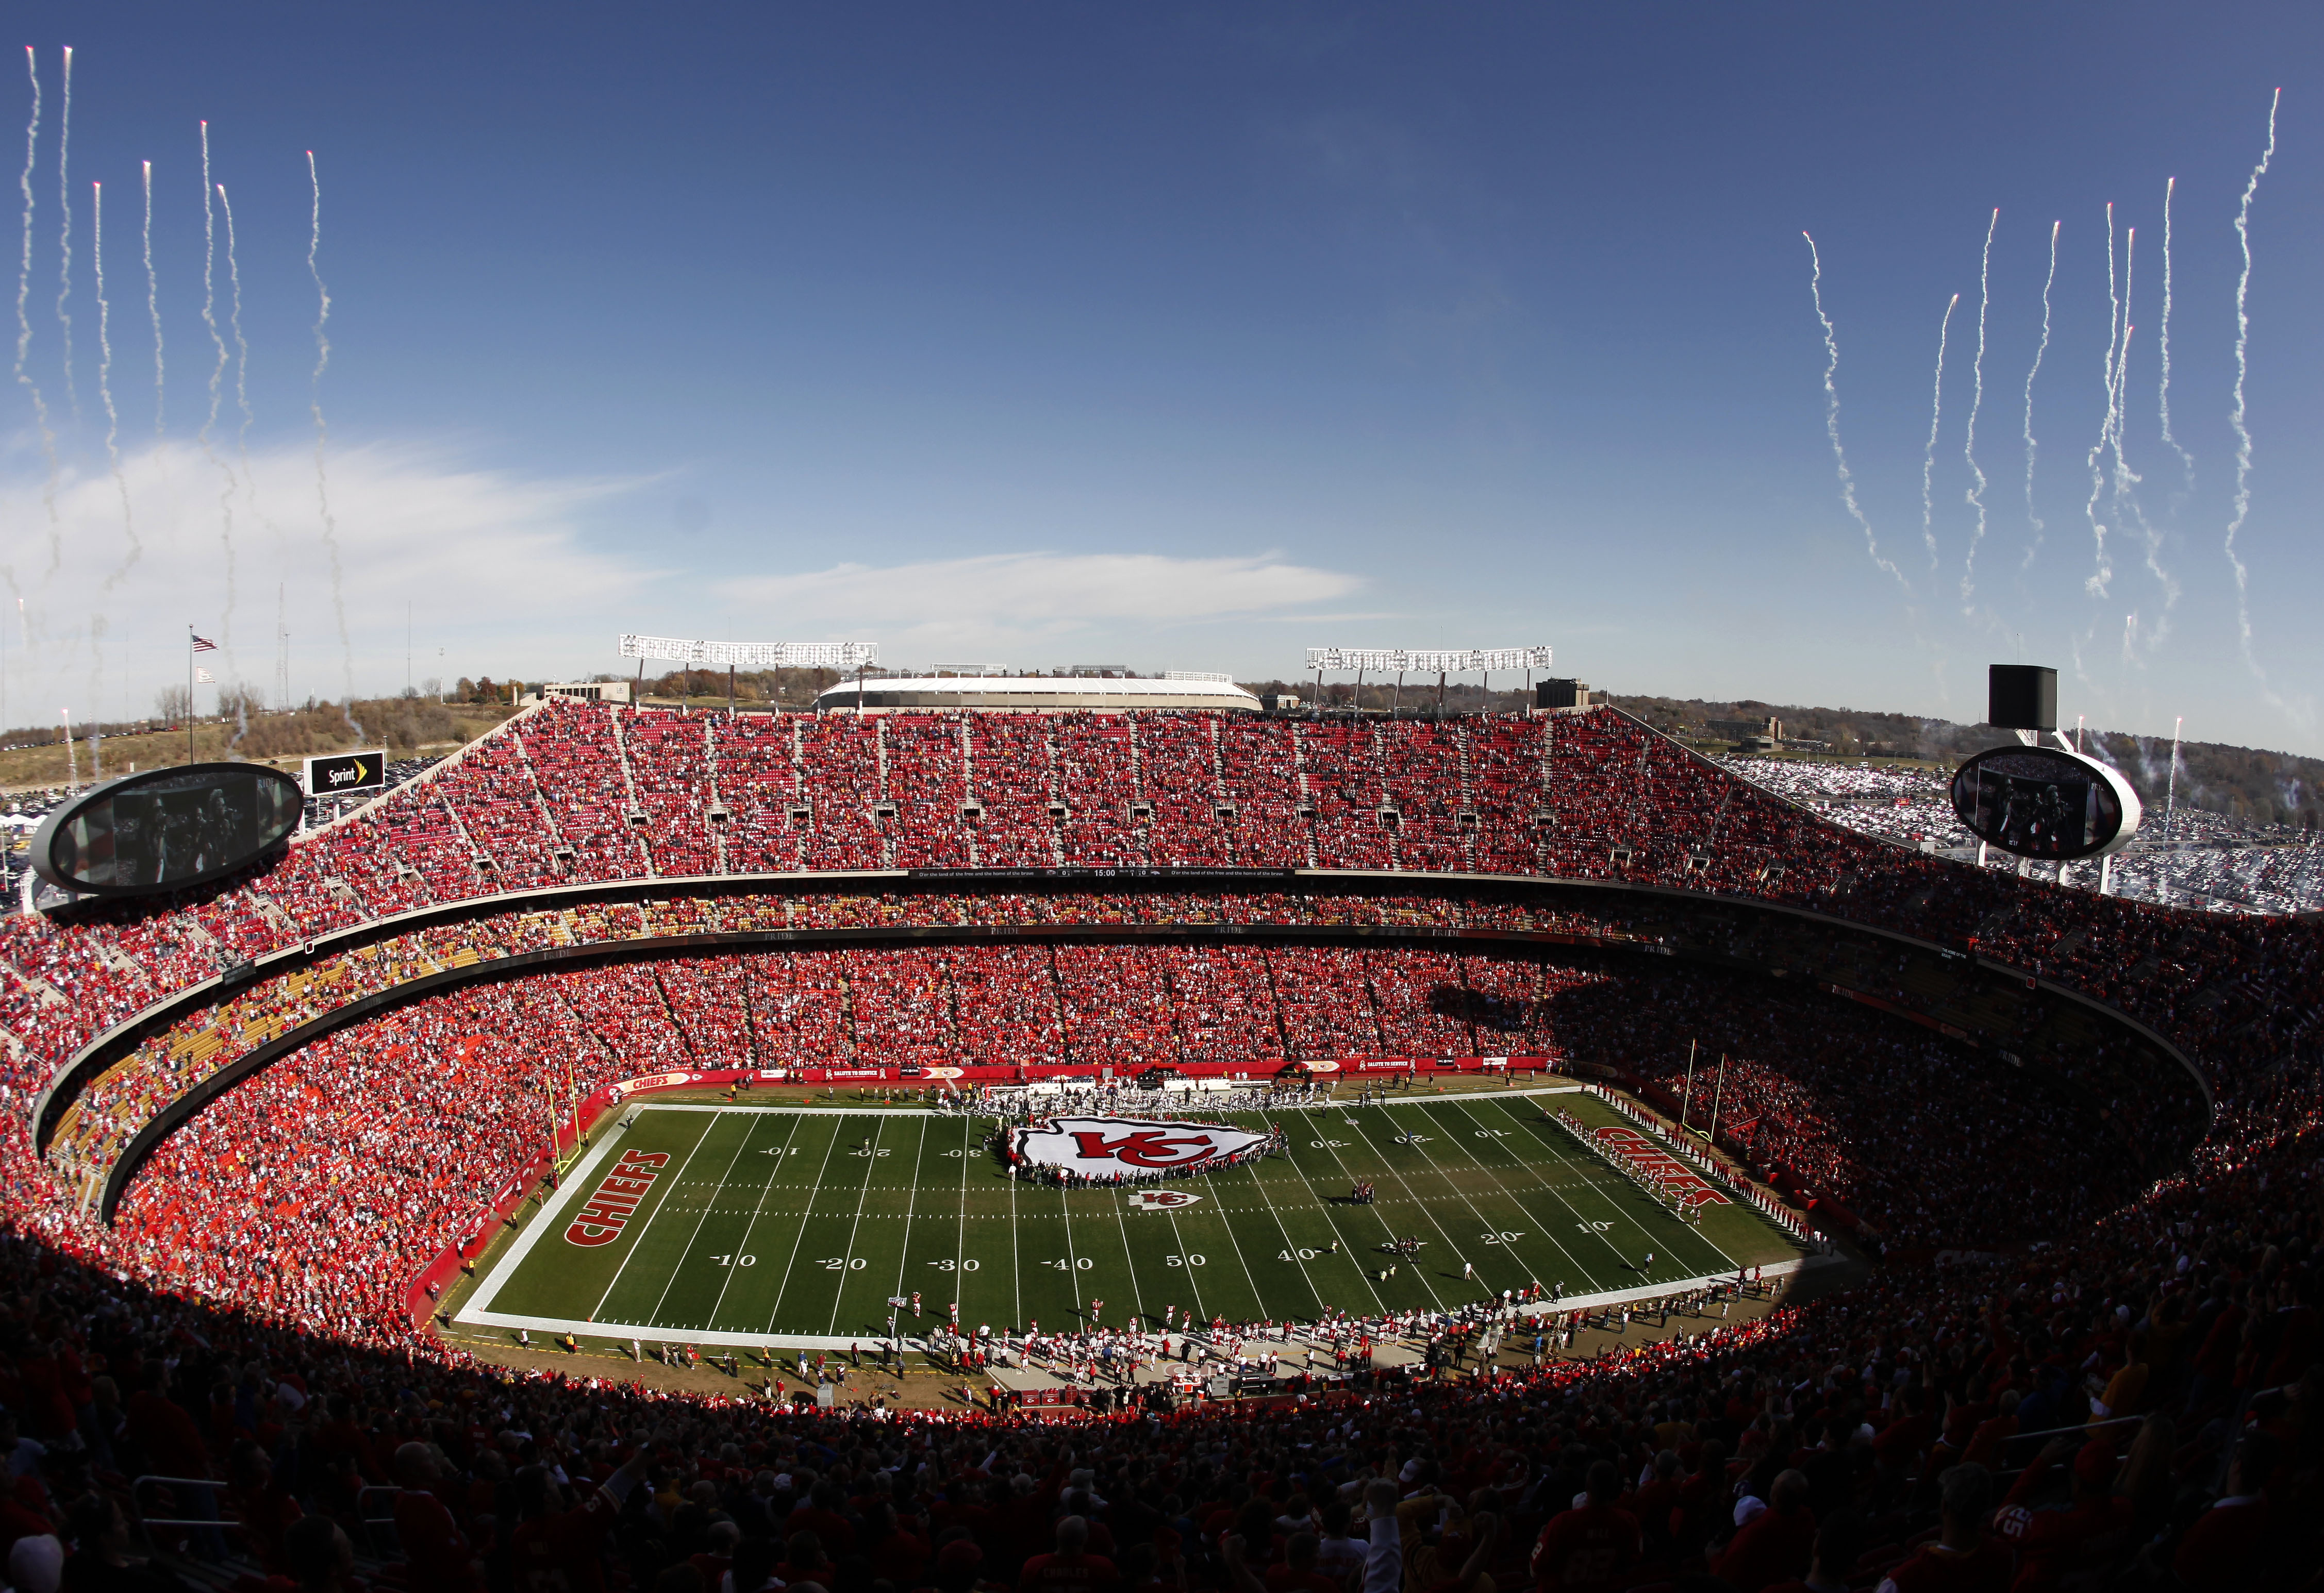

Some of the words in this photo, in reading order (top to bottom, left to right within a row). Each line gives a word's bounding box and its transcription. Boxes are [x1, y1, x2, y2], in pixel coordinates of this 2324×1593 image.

[329, 767, 355, 786] Sprint
[765, 932, 795, 941] PRIDE
[1432, 928, 1460, 937] PRIDE
[543, 949, 571, 961] PRIDE
[1645, 944, 1672, 956] PRIDE
[1832, 984, 1856, 999] PRIDE
[1998, 1048, 2022, 1067] PRIDE
[633, 1076, 669, 1089] CHIEFS
[1475, 1129, 1505, 1138] 10
[1310, 1139, 1342, 1149] 30
[768, 1147, 801, 1155] 10
[948, 1148, 982, 1158] 30
[564, 1148, 671, 1247] CHIEFS
[1575, 1220, 1609, 1234] 10
[1480, 1231, 1518, 1245] 20
[718, 1254, 756, 1267] 10
[1166, 1254, 1206, 1267] 50
[1277, 1248, 1315, 1263] 40
[826, 1257, 867, 1270] 20
[939, 1259, 980, 1271] 30
[1053, 1257, 1093, 1270] 40
[2003, 1505, 2032, 1538] 25
[1043, 1566, 1089, 1579] CHARLES
